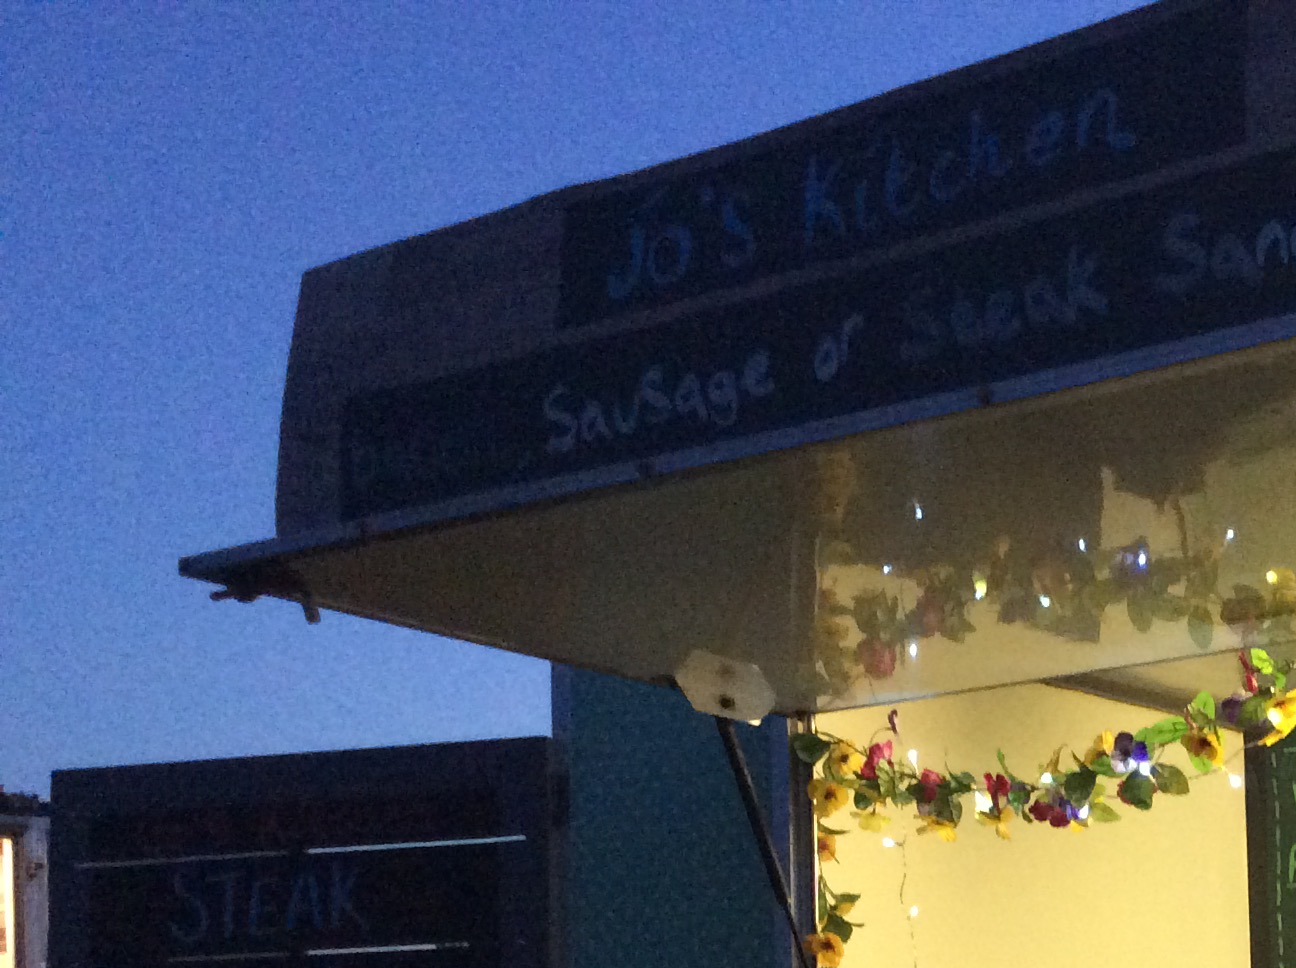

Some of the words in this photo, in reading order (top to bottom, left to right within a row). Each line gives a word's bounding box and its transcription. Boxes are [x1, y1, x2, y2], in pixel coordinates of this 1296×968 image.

[805, 88, 1137, 246] Kitchen
[543, 347, 775, 454] Sausage
[813, 313, 864, 382] or
[168, 861, 369, 944] STEAK
